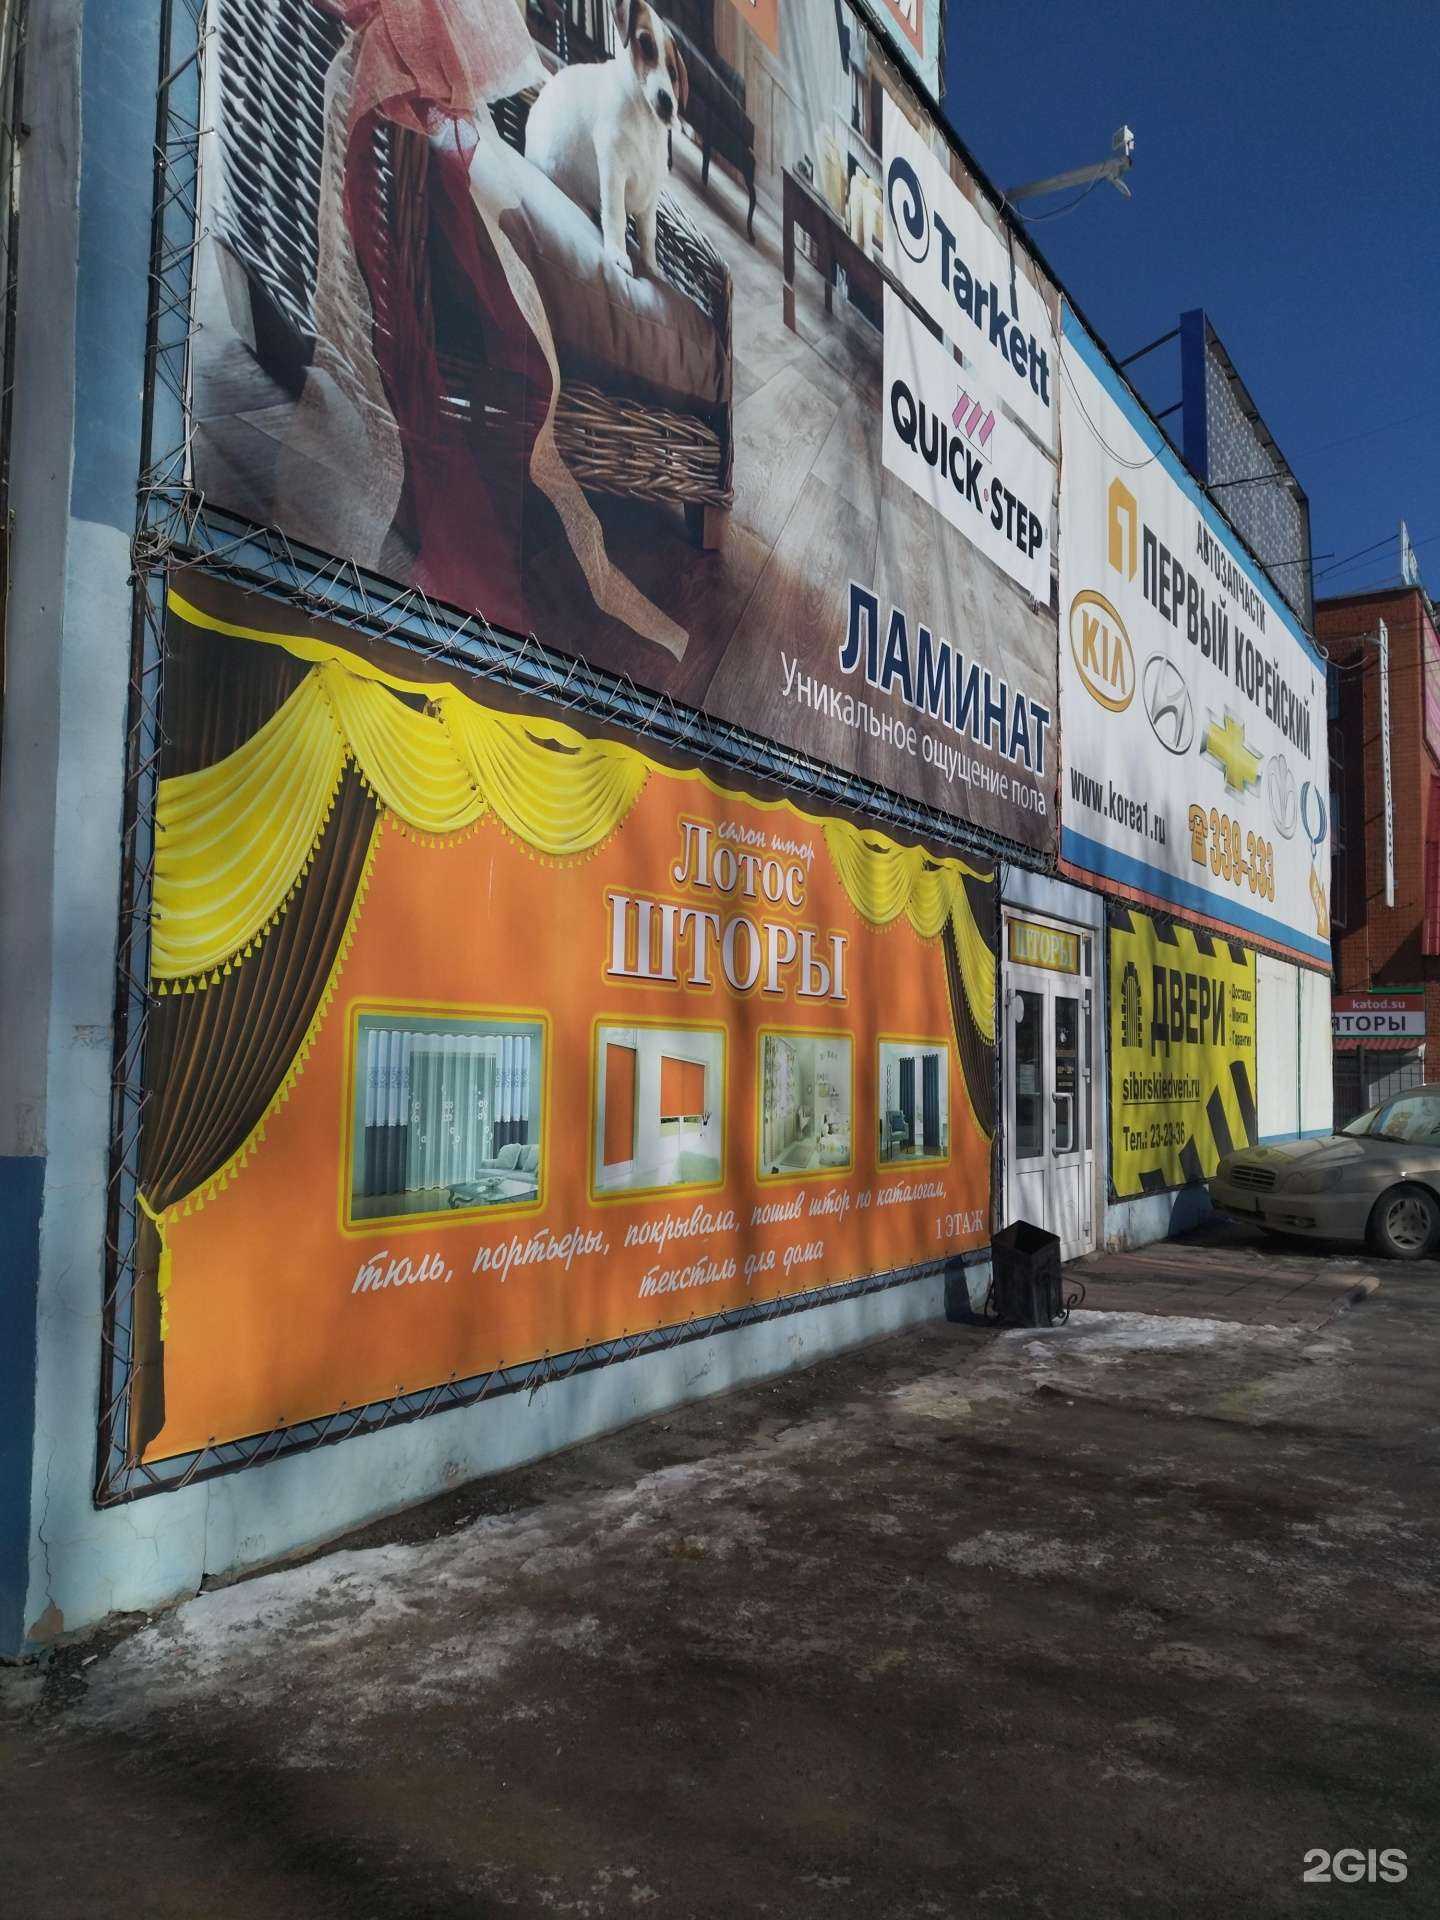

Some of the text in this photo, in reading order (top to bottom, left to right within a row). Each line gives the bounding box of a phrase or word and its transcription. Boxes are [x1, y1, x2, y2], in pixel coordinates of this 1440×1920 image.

[933, 210, 1050, 408] Tarkett
[1196, 520, 1266, 636] АВТОЗАПЧАСТИ
[839, 579, 1050, 778] ЛАМИНАТ
[1081, 607, 1126, 694] KIA
[1142, 522, 1311, 760] ПЕРВЫЙ КОРЕЙСКИЙ
[780, 651, 1047, 816] Уникальное ощущение пола
[718, 822, 815, 873] салон штор
[1070, 766, 1166, 846] www.korea1.ru
[607, 894, 848, 1000] ШТОРЫ
[1151, 964, 1226, 1058] ДВЕРИ
[1352, 999, 1406, 1009] katod.su
[1122, 1071, 1201, 1101] sibirskiedveri.ru
[351, 1180, 947, 1294] тюль, портьеры, покрывала, пошив штор по каталогам,
[638, 1239, 825, 1299] текстиль для дома
[936, 1209, 984, 1240] 1 ЭТАЖ
